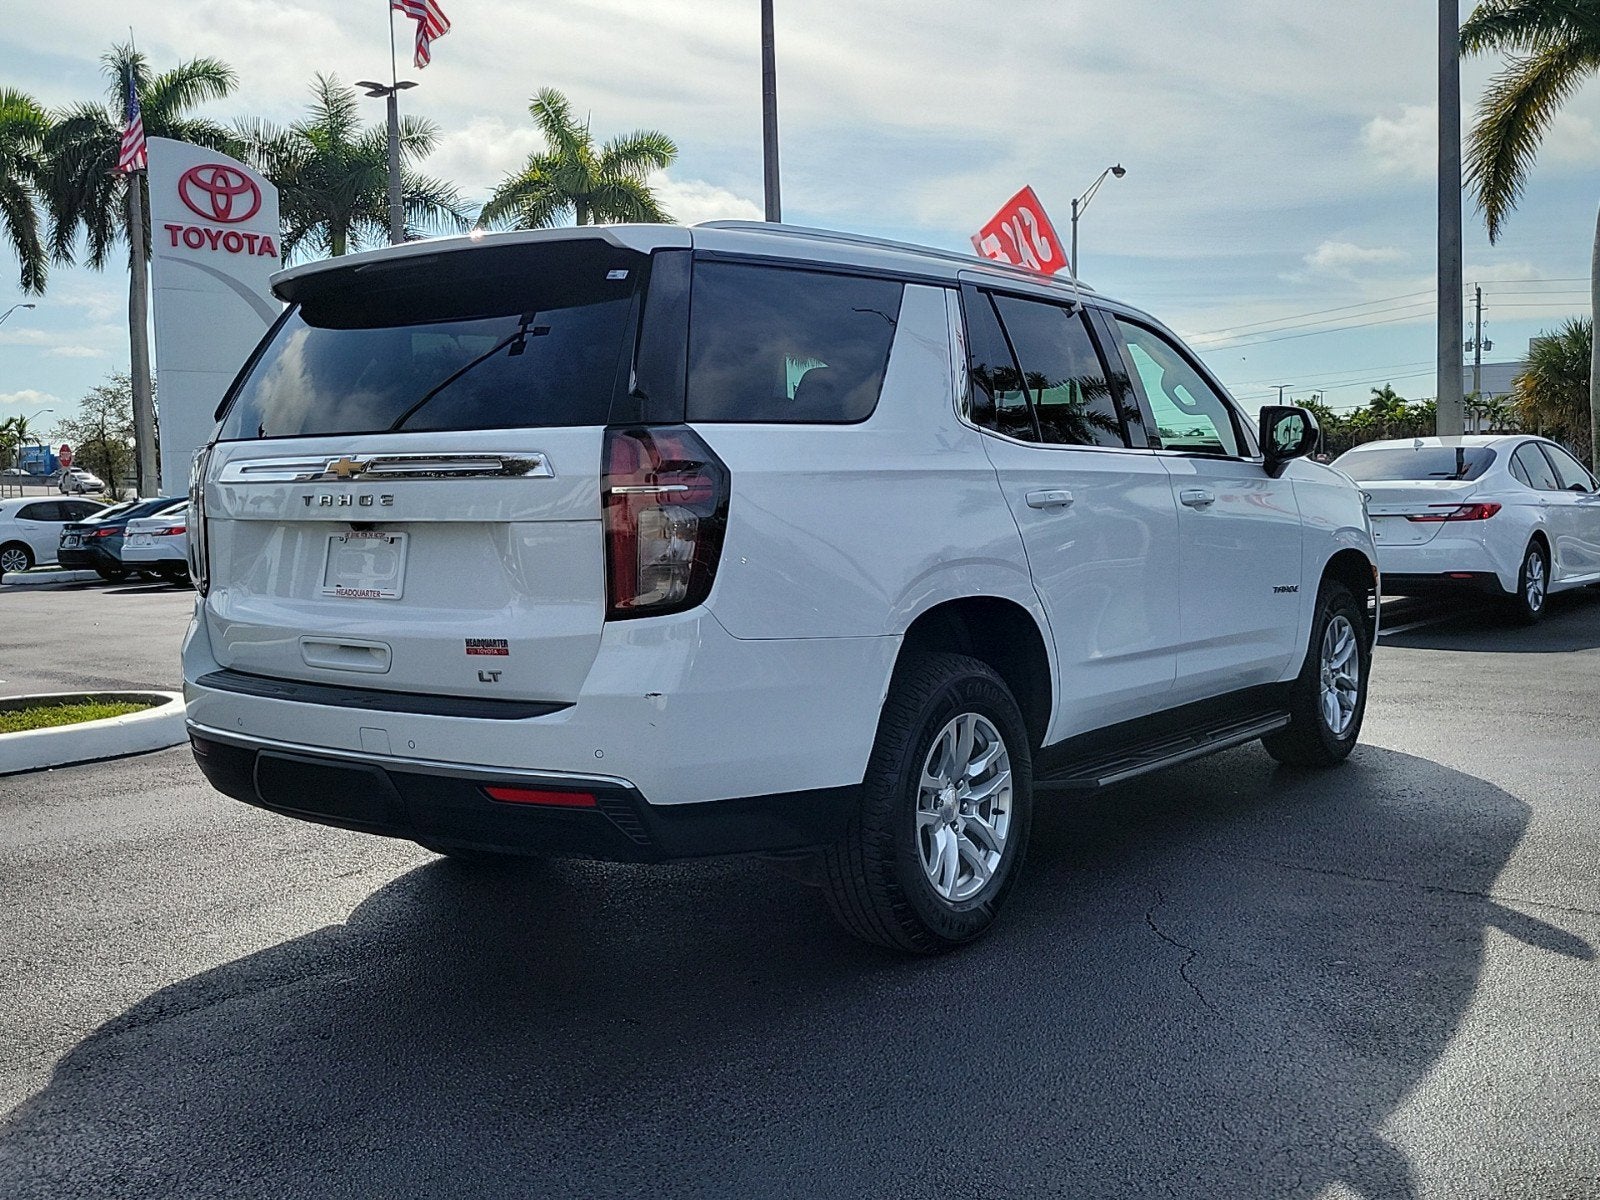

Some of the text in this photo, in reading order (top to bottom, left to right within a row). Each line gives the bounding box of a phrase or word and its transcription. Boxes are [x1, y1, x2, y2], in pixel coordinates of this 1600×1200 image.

[164, 224, 278, 257] TOYOTA
[302, 494, 394, 507] TAHOE
[336, 588, 381, 598] HEADQUARTER
[1272, 585, 1299, 593] TAHOE
[465, 638, 509, 649] HEADQUARTER
[478, 669, 502, 683] LT
